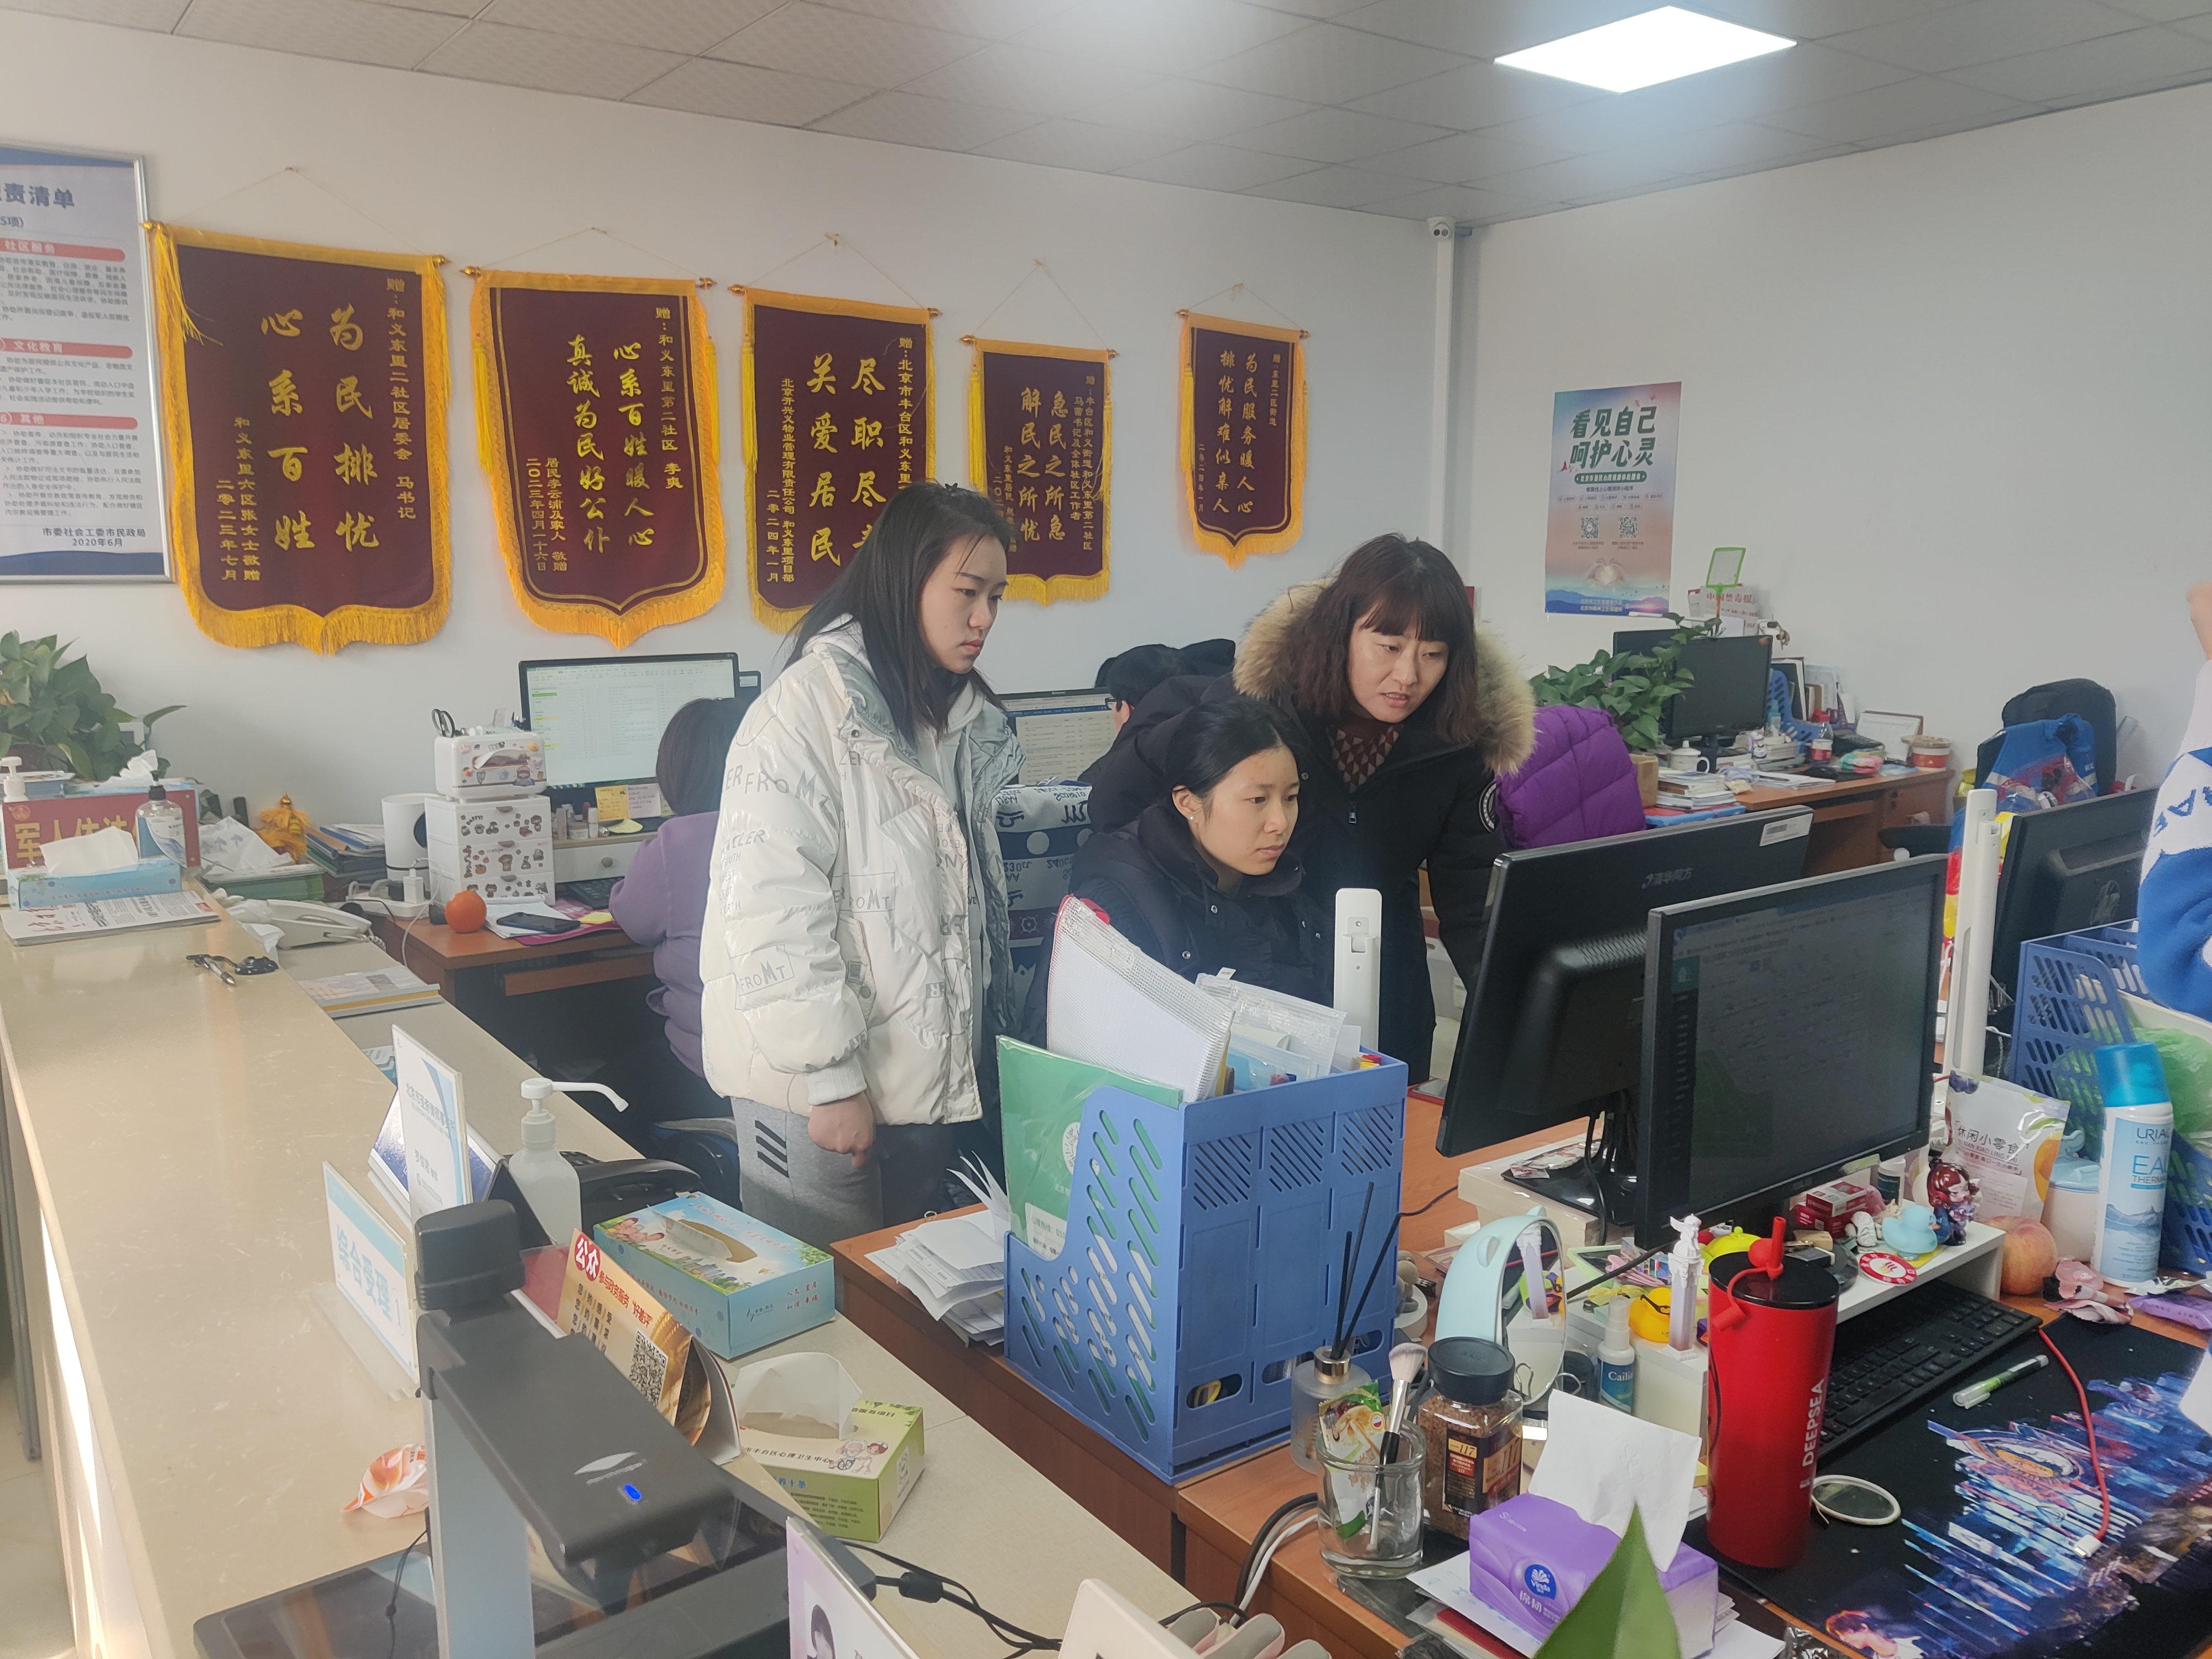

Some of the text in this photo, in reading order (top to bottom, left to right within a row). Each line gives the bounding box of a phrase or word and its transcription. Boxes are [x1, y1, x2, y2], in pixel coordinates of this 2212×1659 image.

[1, 182, 75, 208] 责清单
[13, 340, 62, 353] 文化教育
[20, 413, 44, 424] 其他
[262, 309, 315, 551] 心系百姓
[330, 304, 380, 551] 为民排忧
[898, 337, 914, 490] 赠：北京市丰台区和义东里
[1213, 349, 1235, 513] 排忧解难似亲人
[1237, 352, 1258, 514] 为民服务暖人心
[1570, 406, 1657, 440] 看见自己
[566, 334, 610, 554] 真诚为民好公仆
[613, 342, 654, 546] 心系百姓暖人心
[807, 353, 841, 567] 关爱居民
[1017, 387, 1041, 542] 解民之所忧
[1045, 390, 1068, 541] 急民之所急
[1569, 437, 1656, 469] 呵护心灵
[396, 476, 416, 520] 马书记
[664, 462, 684, 489] 李爽
[43, 527, 146, 538] 市委社会工委市民政局
[72, 538, 123, 547] 2020年6月
[216, 479, 239, 581] 二零二三年七月
[766, 489, 780, 582] 二零二四年一月
[782, 520, 795, 582] 和义东里项目部
[552, 551, 568, 572] 敬赠
[1958, 1125, 2020, 1155] 休闲小零食
[576, 1238, 599, 1280] 公众
[599, 1271, 630, 1308] 参与政务服务
[1802, 1378, 1825, 1467] DEEPSEA
[1530, 1578, 1551, 1593] Vinda
